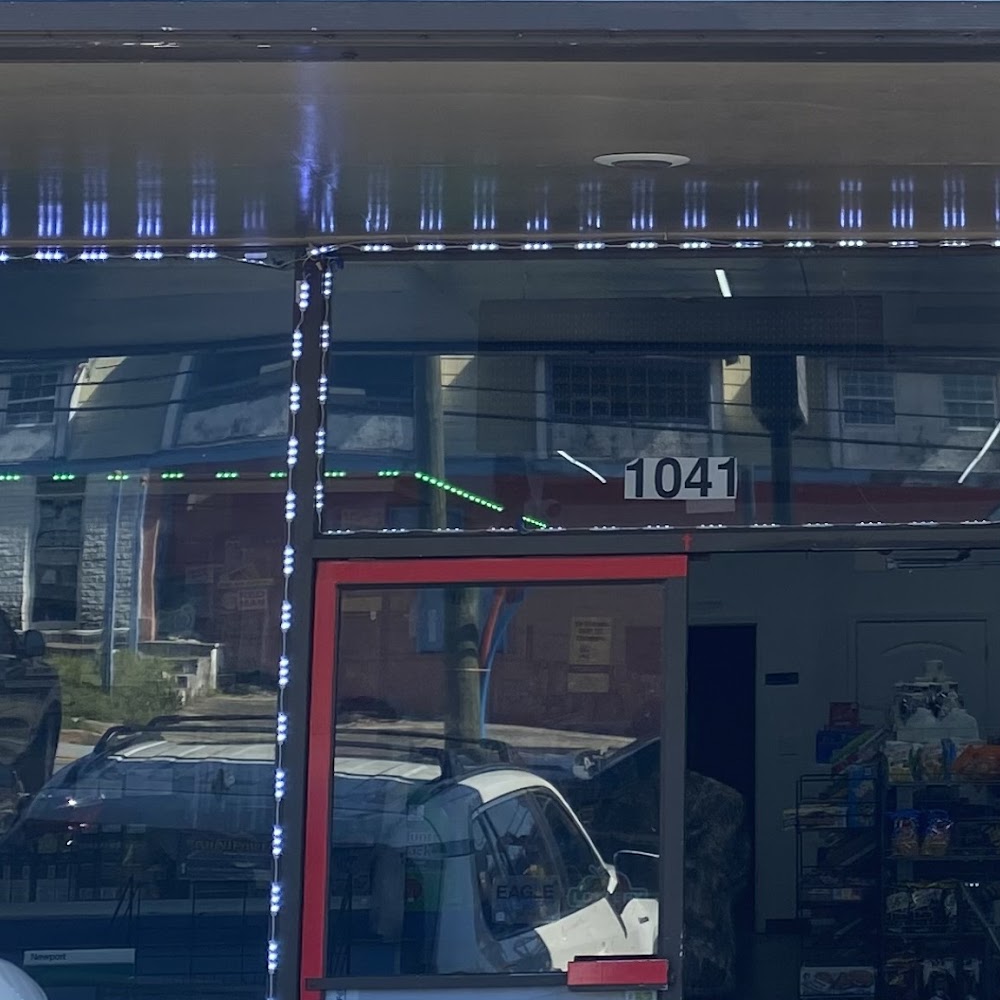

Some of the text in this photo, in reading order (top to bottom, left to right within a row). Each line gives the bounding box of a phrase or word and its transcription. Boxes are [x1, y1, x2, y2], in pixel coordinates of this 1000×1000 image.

[626, 456, 736, 499] 1041
[496, 884, 554, 900] EAGLE
[30, 952, 67, 963] Newport
